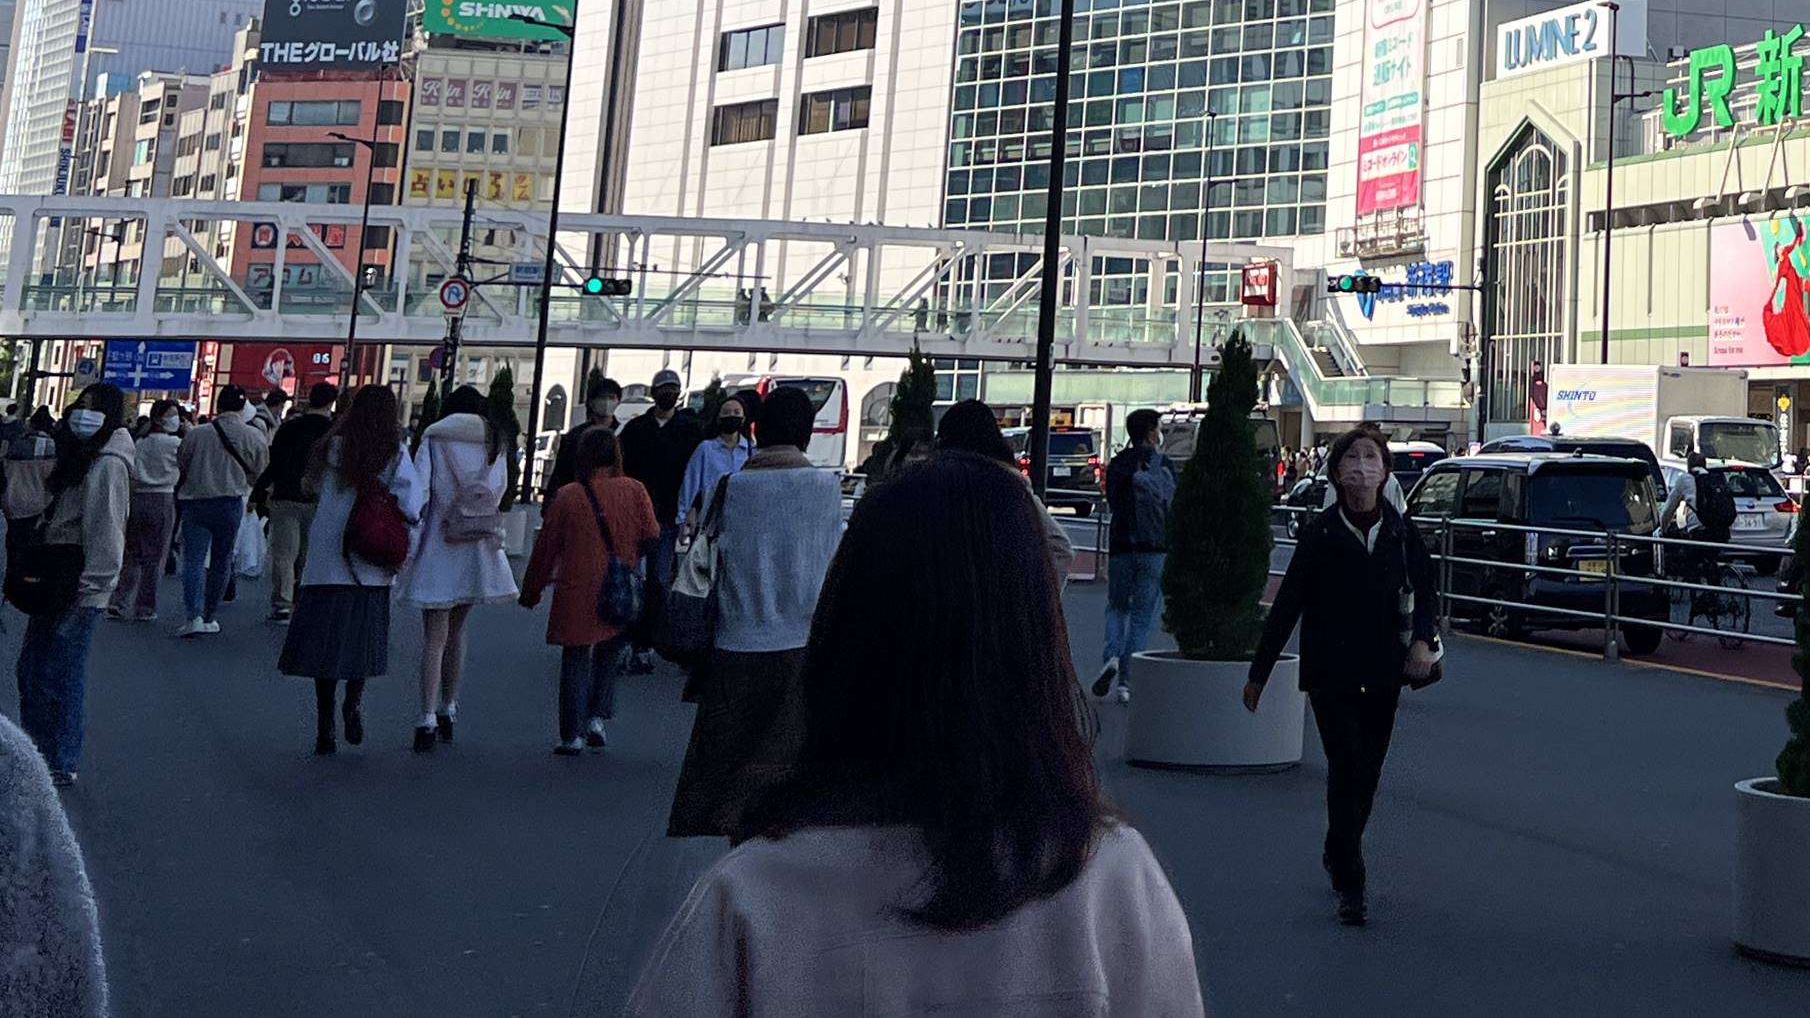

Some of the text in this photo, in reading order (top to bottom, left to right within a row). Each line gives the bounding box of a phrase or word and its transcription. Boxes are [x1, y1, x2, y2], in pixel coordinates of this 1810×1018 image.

[1504, 8, 1598, 71] LUMINE 2
[260, 41, 400, 64] THEグローバル社
[1556, 390, 1597, 401] SHINTO
